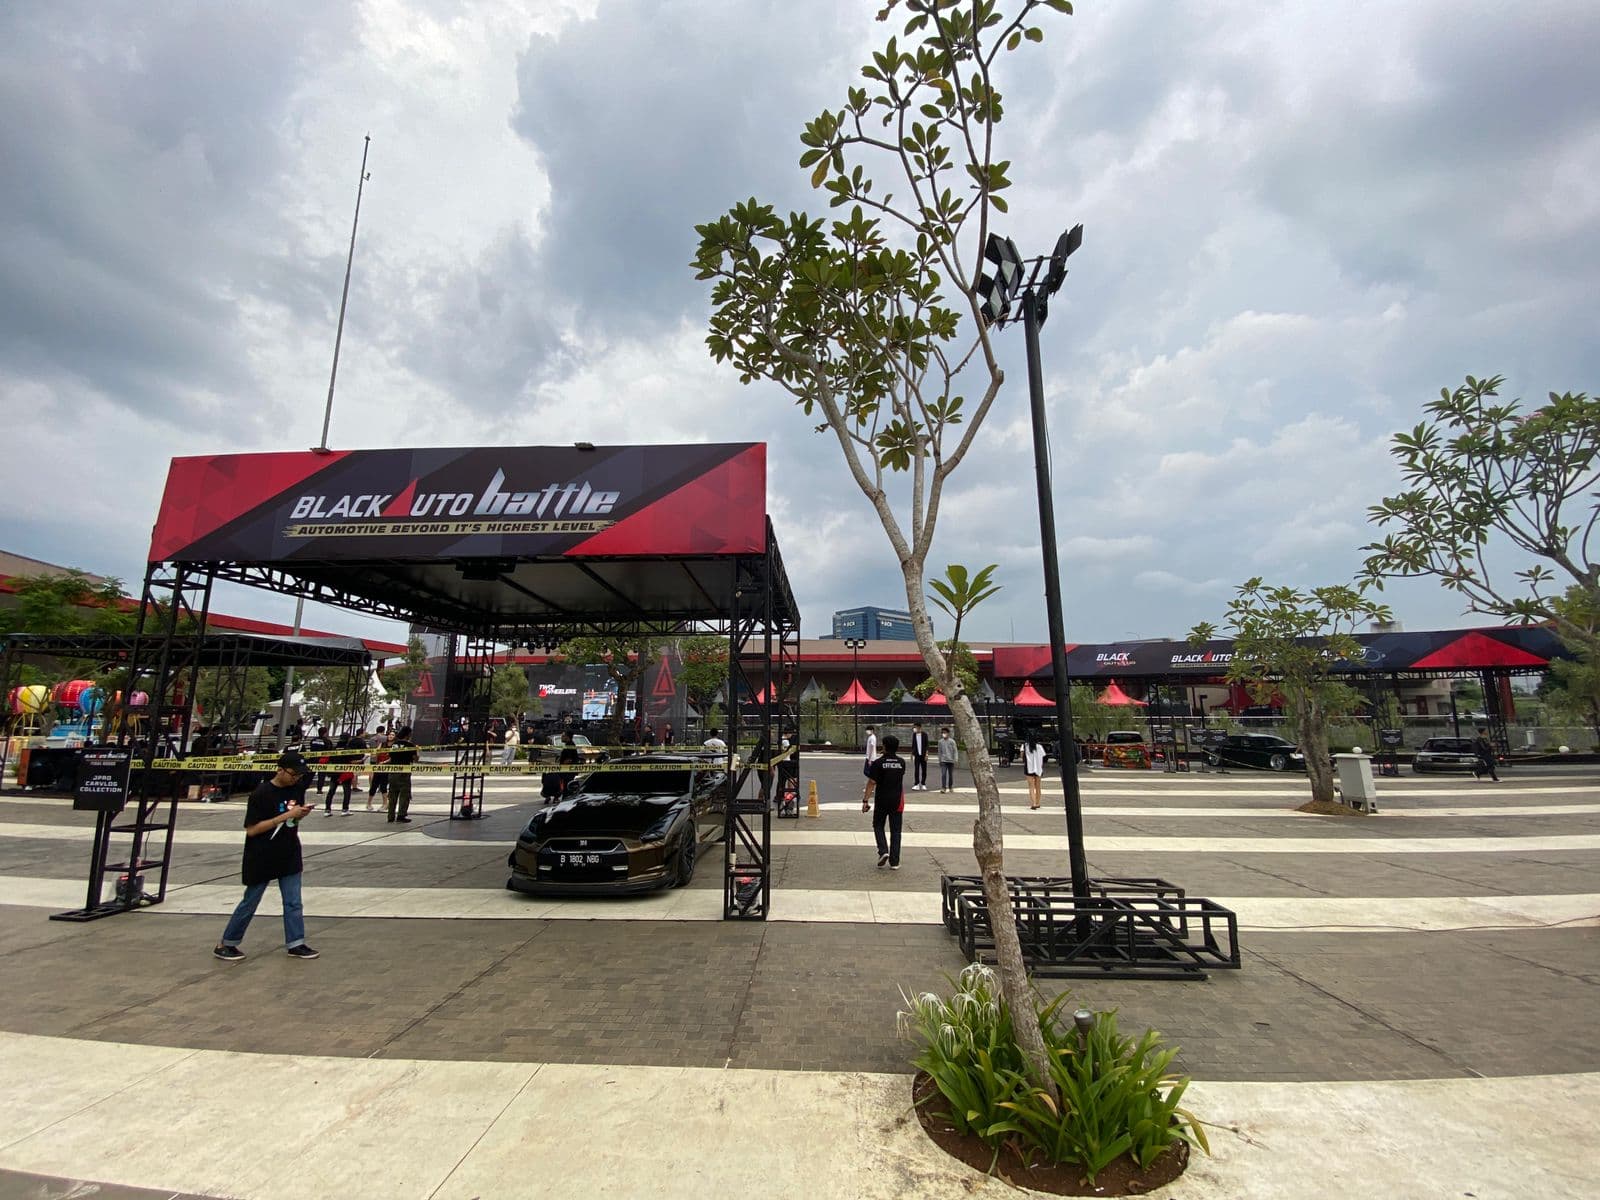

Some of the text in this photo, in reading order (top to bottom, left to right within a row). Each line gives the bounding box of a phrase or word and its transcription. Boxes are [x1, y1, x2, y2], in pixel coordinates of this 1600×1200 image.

[290, 494, 392, 519] BLACK
[473, 467, 621, 520] battle
[298, 522, 596, 535] AUTOMOTIVE BEYOND IT'S HIGHEST LEVEL
[1096, 652, 1131, 661] BLACK
[1170, 654, 1205, 663] BLACK
[152, 761, 181, 769] CAUTION
[560, 855, 566, 863] B
